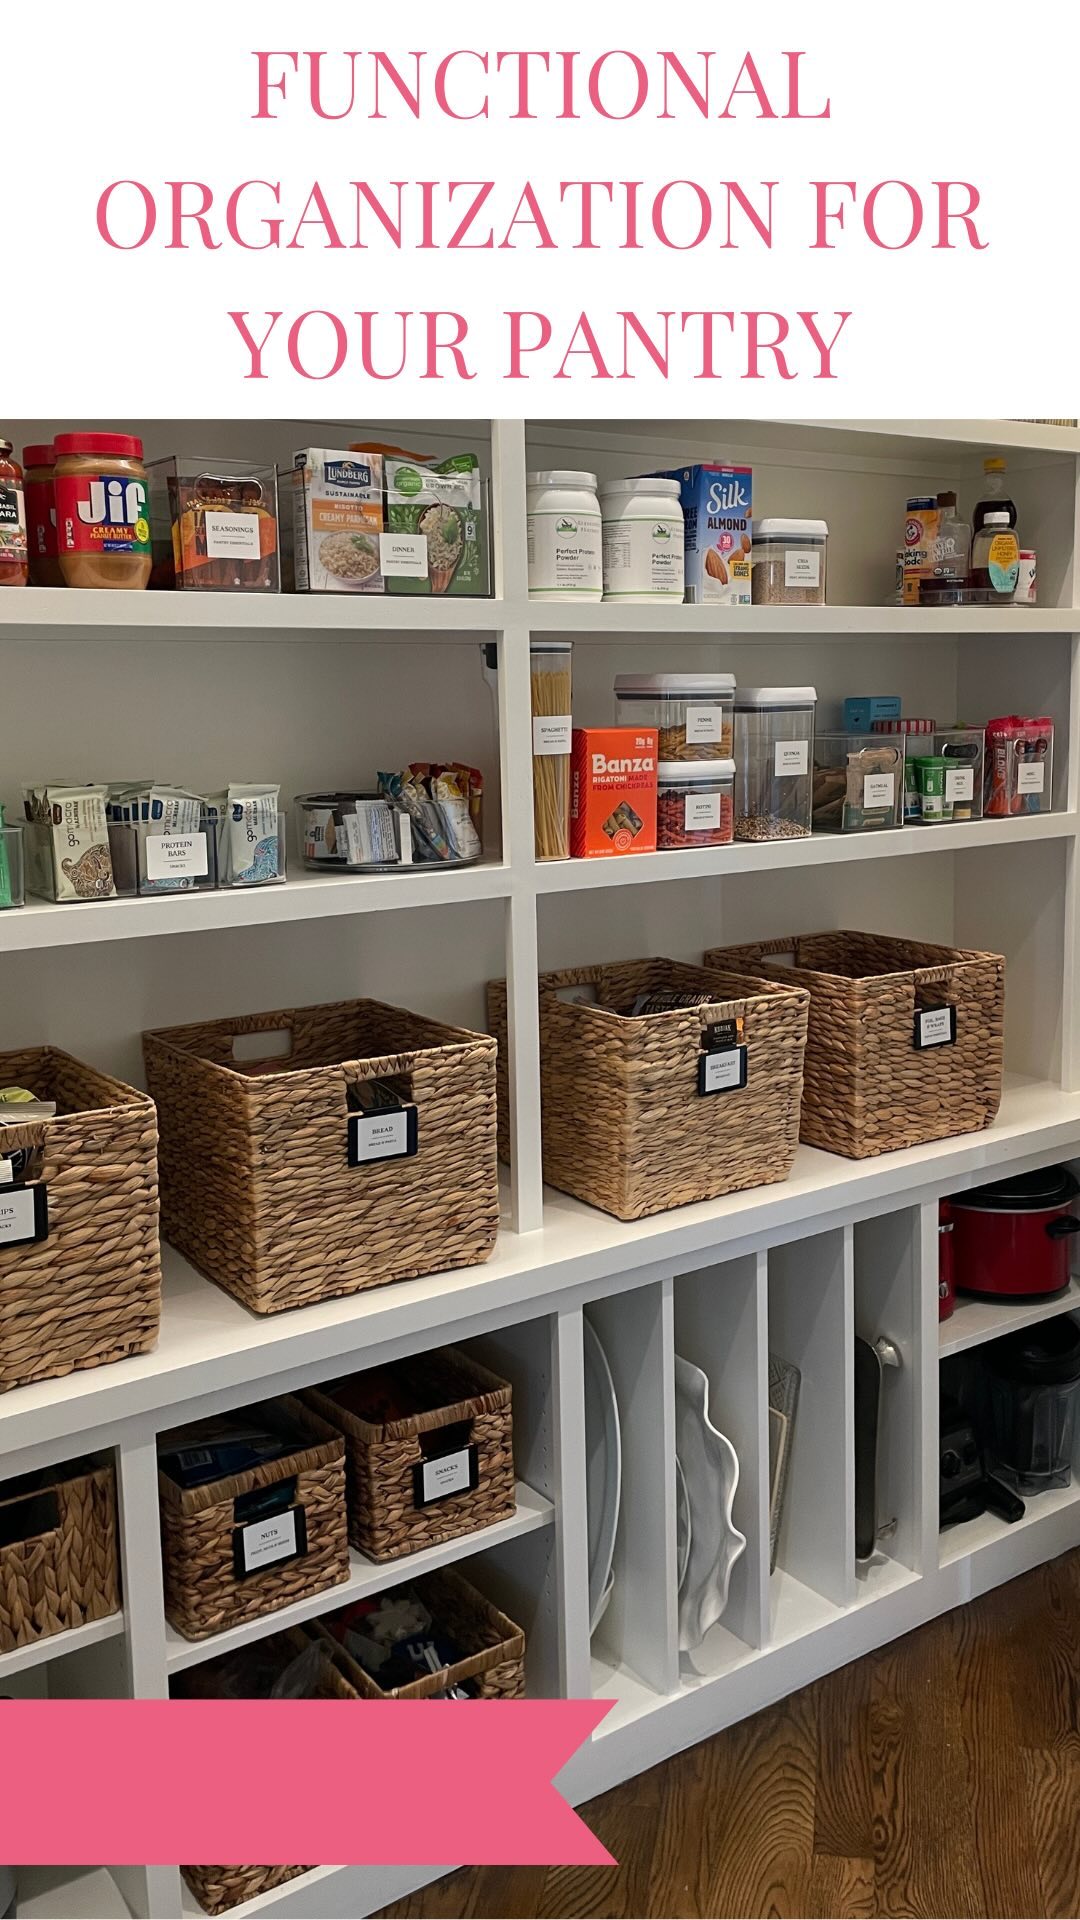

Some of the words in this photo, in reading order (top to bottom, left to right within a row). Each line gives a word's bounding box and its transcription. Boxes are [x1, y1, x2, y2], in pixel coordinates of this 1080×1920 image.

[327, 466, 369, 483] LUNDBERG
[325, 490, 371, 500] SUSTAINABLE
[706, 481, 749, 514] Silk
[77, 480, 146, 524] Jif
[319, 512, 344, 523] CREAMY
[707, 516, 747, 531] ALMOND
[92, 526, 129, 535] CREAMY
[211, 525, 254, 534] SEASONINGS
[466, 525, 473, 535] 9
[722, 535, 731, 544] 30
[904, 549, 928, 559] aking
[540, 726, 568, 734] SPAGHETTI
[592, 753, 654, 775] Banza
[592, 775, 627, 784] RIGATONI
[627, 774, 648, 783] MADE
[592, 783, 615, 791] FROM
[615, 781, 653, 791] CHICKPEAS
[571, 771, 580, 819] Banza
[161, 840, 193, 850] PROTEIN
[168, 849, 186, 857] BARS
[678, 994, 713, 1005] GRAINS
[713, 1024, 732, 1034] KODIAK
[710, 1060, 736, 1071] BREAKFAST
[371, 1125, 394, 1136] BREAD
[0, 1207, 14, 1216] IPS
[435, 1464, 459, 1476] SNACKS
[260, 1528, 278, 1540] NUTS
